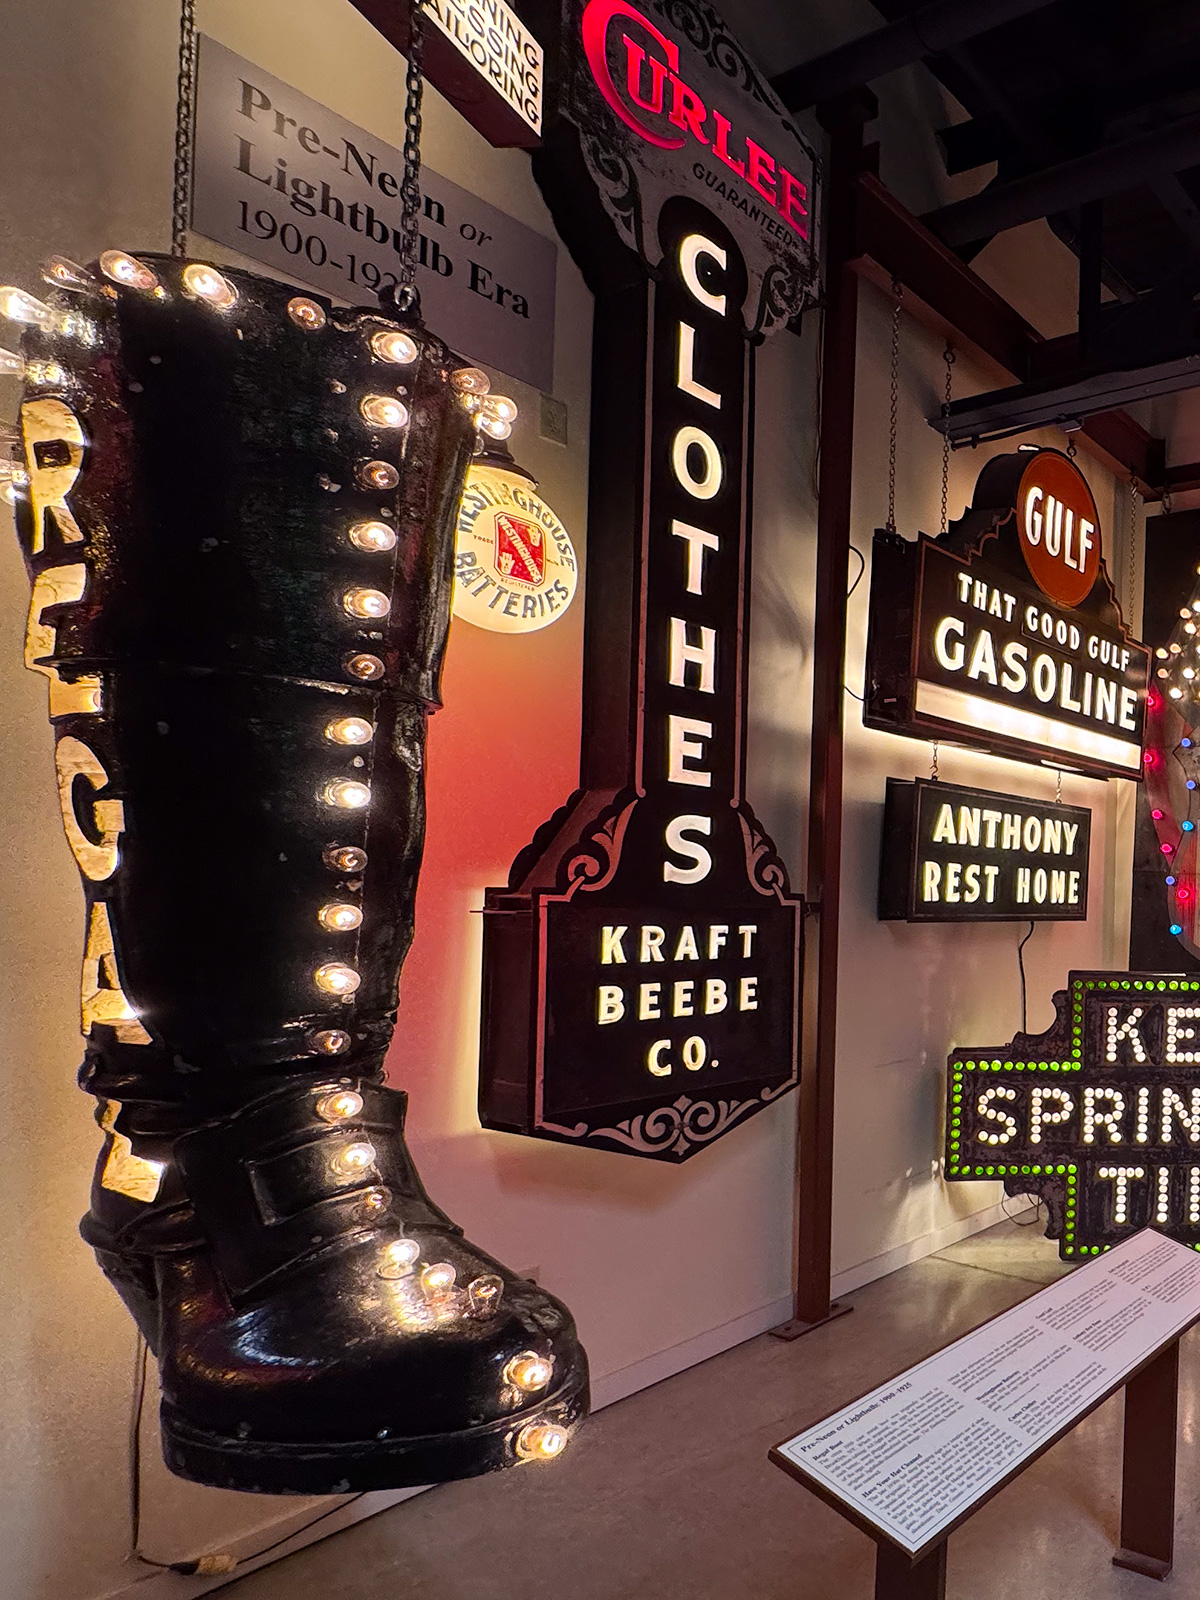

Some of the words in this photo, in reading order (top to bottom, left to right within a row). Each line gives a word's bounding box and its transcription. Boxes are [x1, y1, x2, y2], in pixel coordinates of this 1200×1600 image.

[421, 0, 540, 124] AILORING
[482, 0, 540, 69] NING
[582, 0, 808, 241] CURLEE
[459, 223, 492, 247] or
[692, 162, 798, 248] GUARANTEED
[238, 201, 400, 292] 1900-19
[467, 259, 530, 319] Era
[663, 233, 727, 886] CLOTHES
[1024, 486, 1095, 574] GULF
[455, 551, 569, 619] BATTERIES
[957, 571, 1017, 623] THAT
[1026, 605, 1080, 651] GOOD
[1087, 635, 1131, 673] GULF
[935, 619, 1138, 732] GASOLINE
[932, 803, 1080, 856] ANTHONY
[922, 863, 999, 905] REST
[1016, 867, 1080, 905] HOME
[601, 924, 758, 965] KRAFT
[597, 977, 760, 1026] BEEBE
[647, 1036, 720, 1077] CO.
